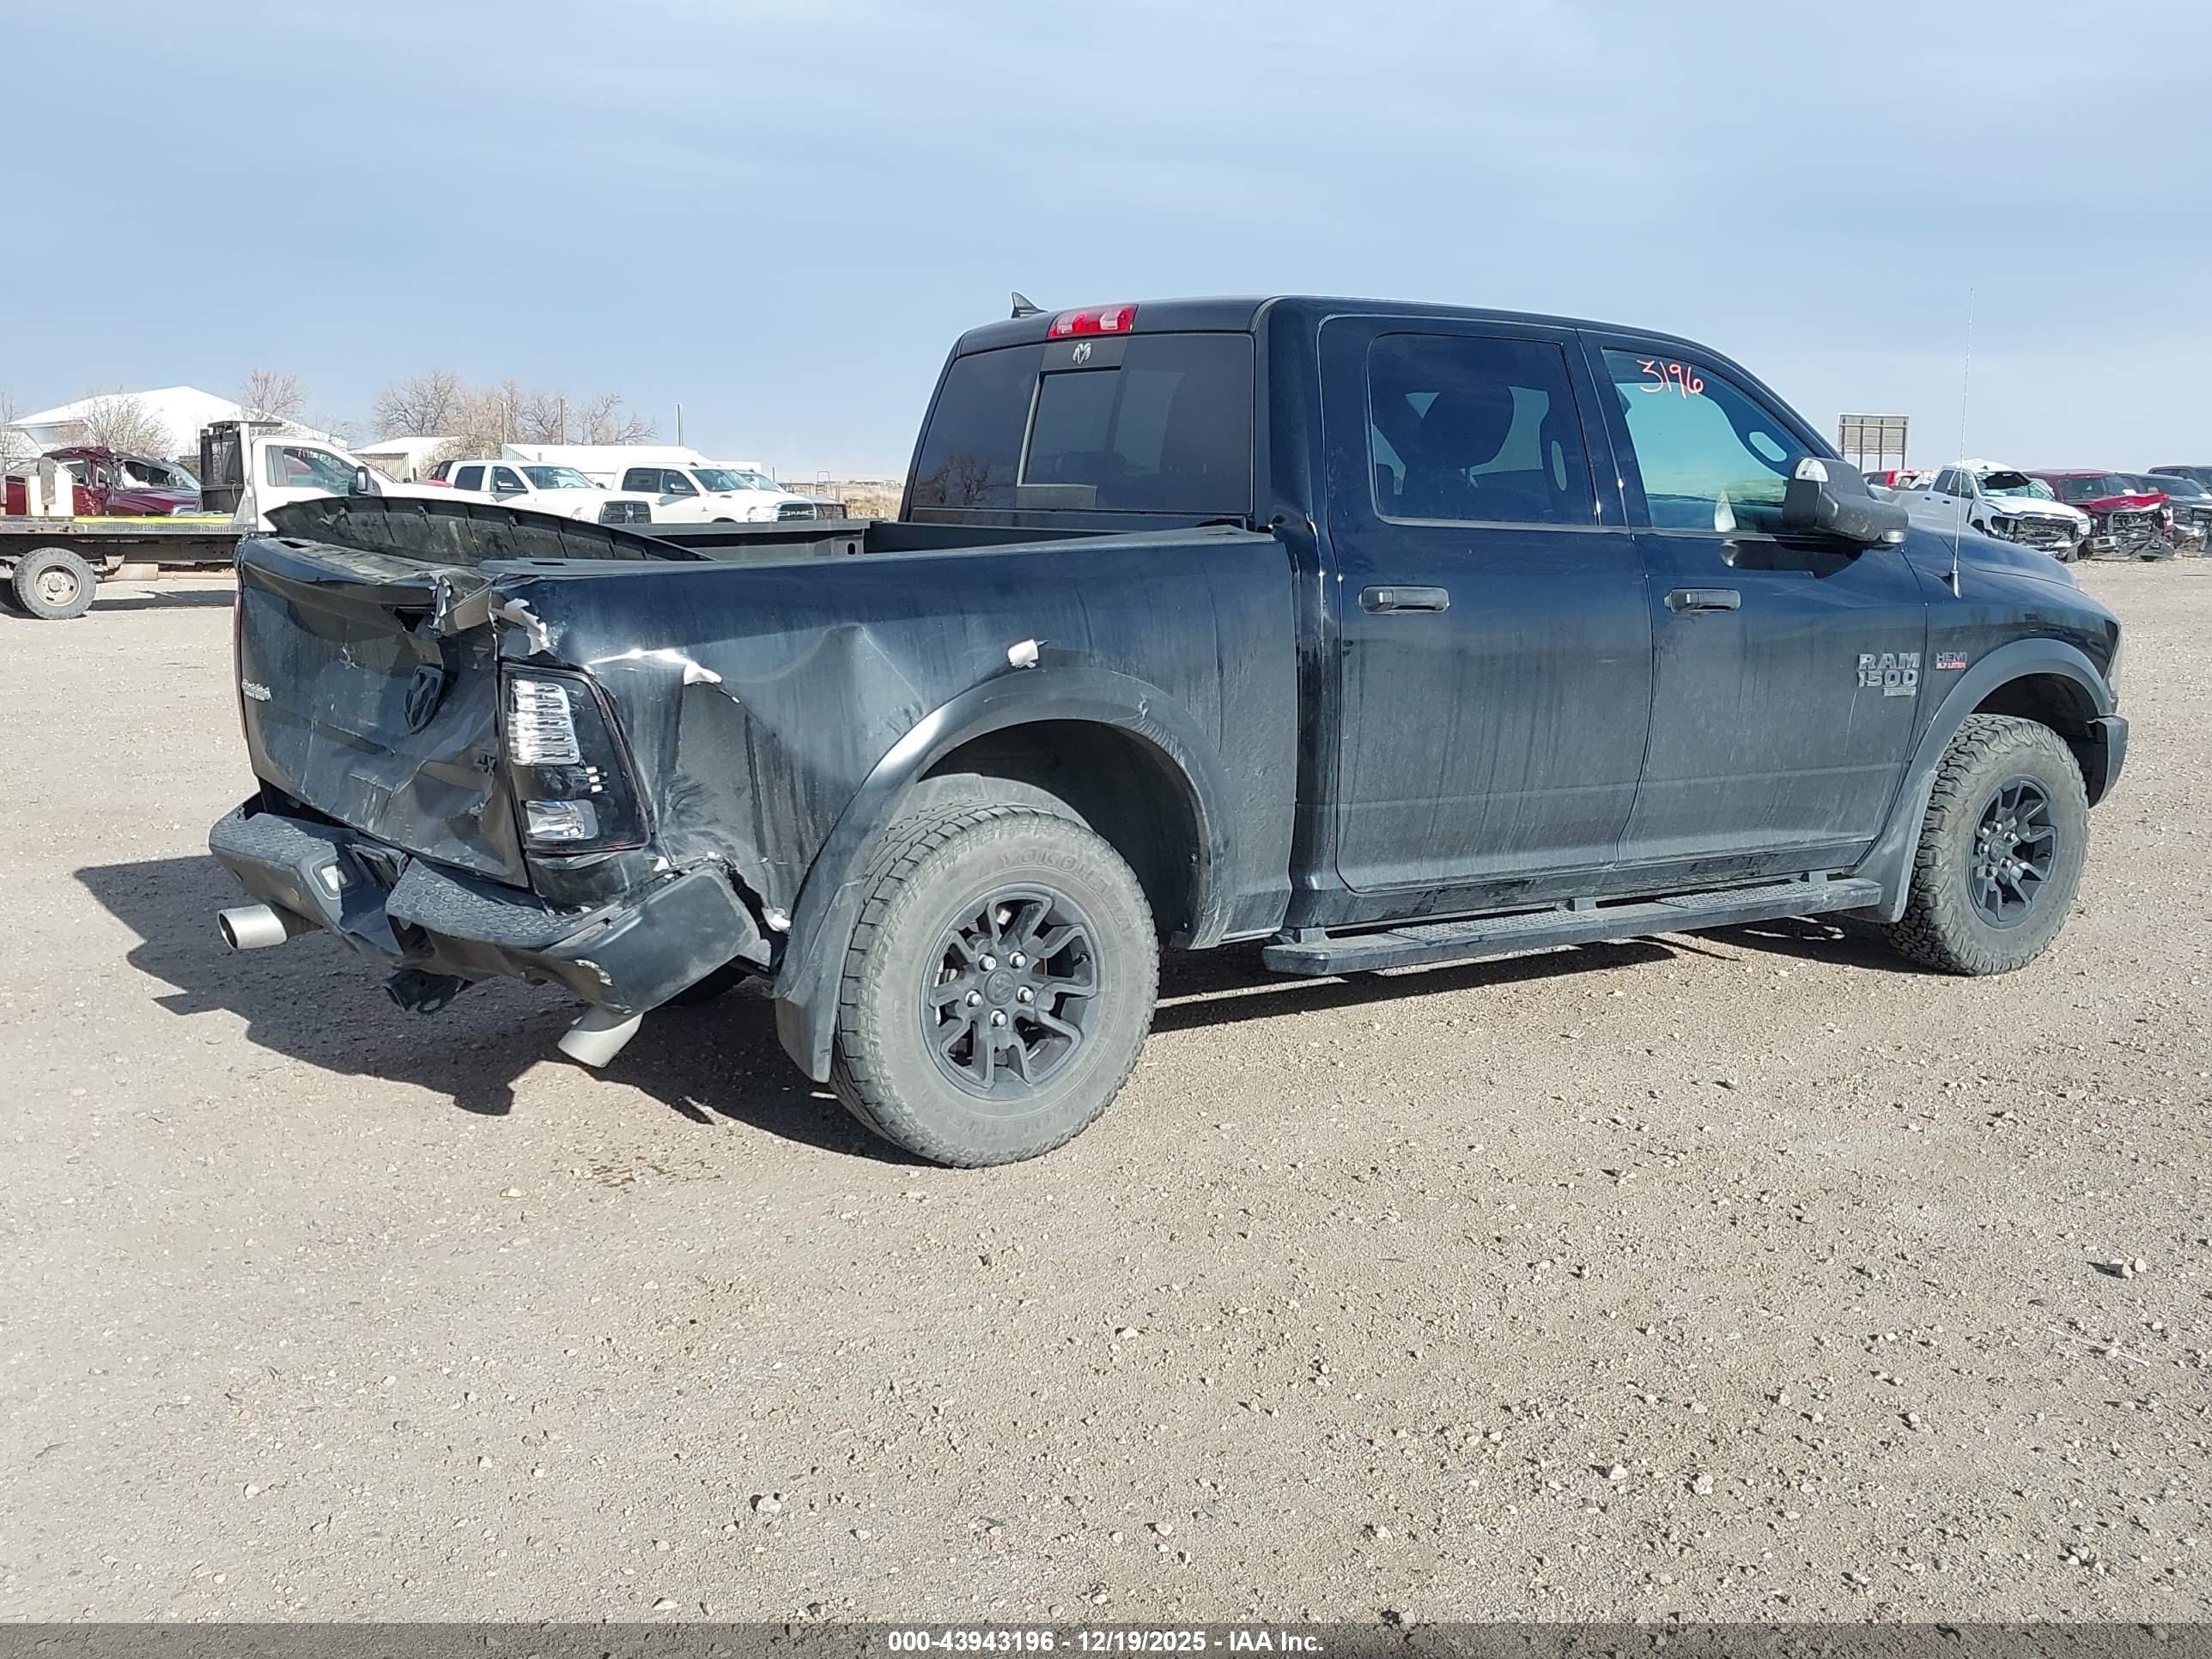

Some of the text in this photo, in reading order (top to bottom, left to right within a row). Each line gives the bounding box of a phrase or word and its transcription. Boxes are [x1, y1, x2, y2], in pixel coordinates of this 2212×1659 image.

[1636, 360, 1704, 398] 3196
[1858, 653, 1920, 670] RAM
[1936, 652, 1967, 662] HEMI
[1857, 670, 1919, 687] 1500
[999, 848, 1135, 935] YOKOHAMA
